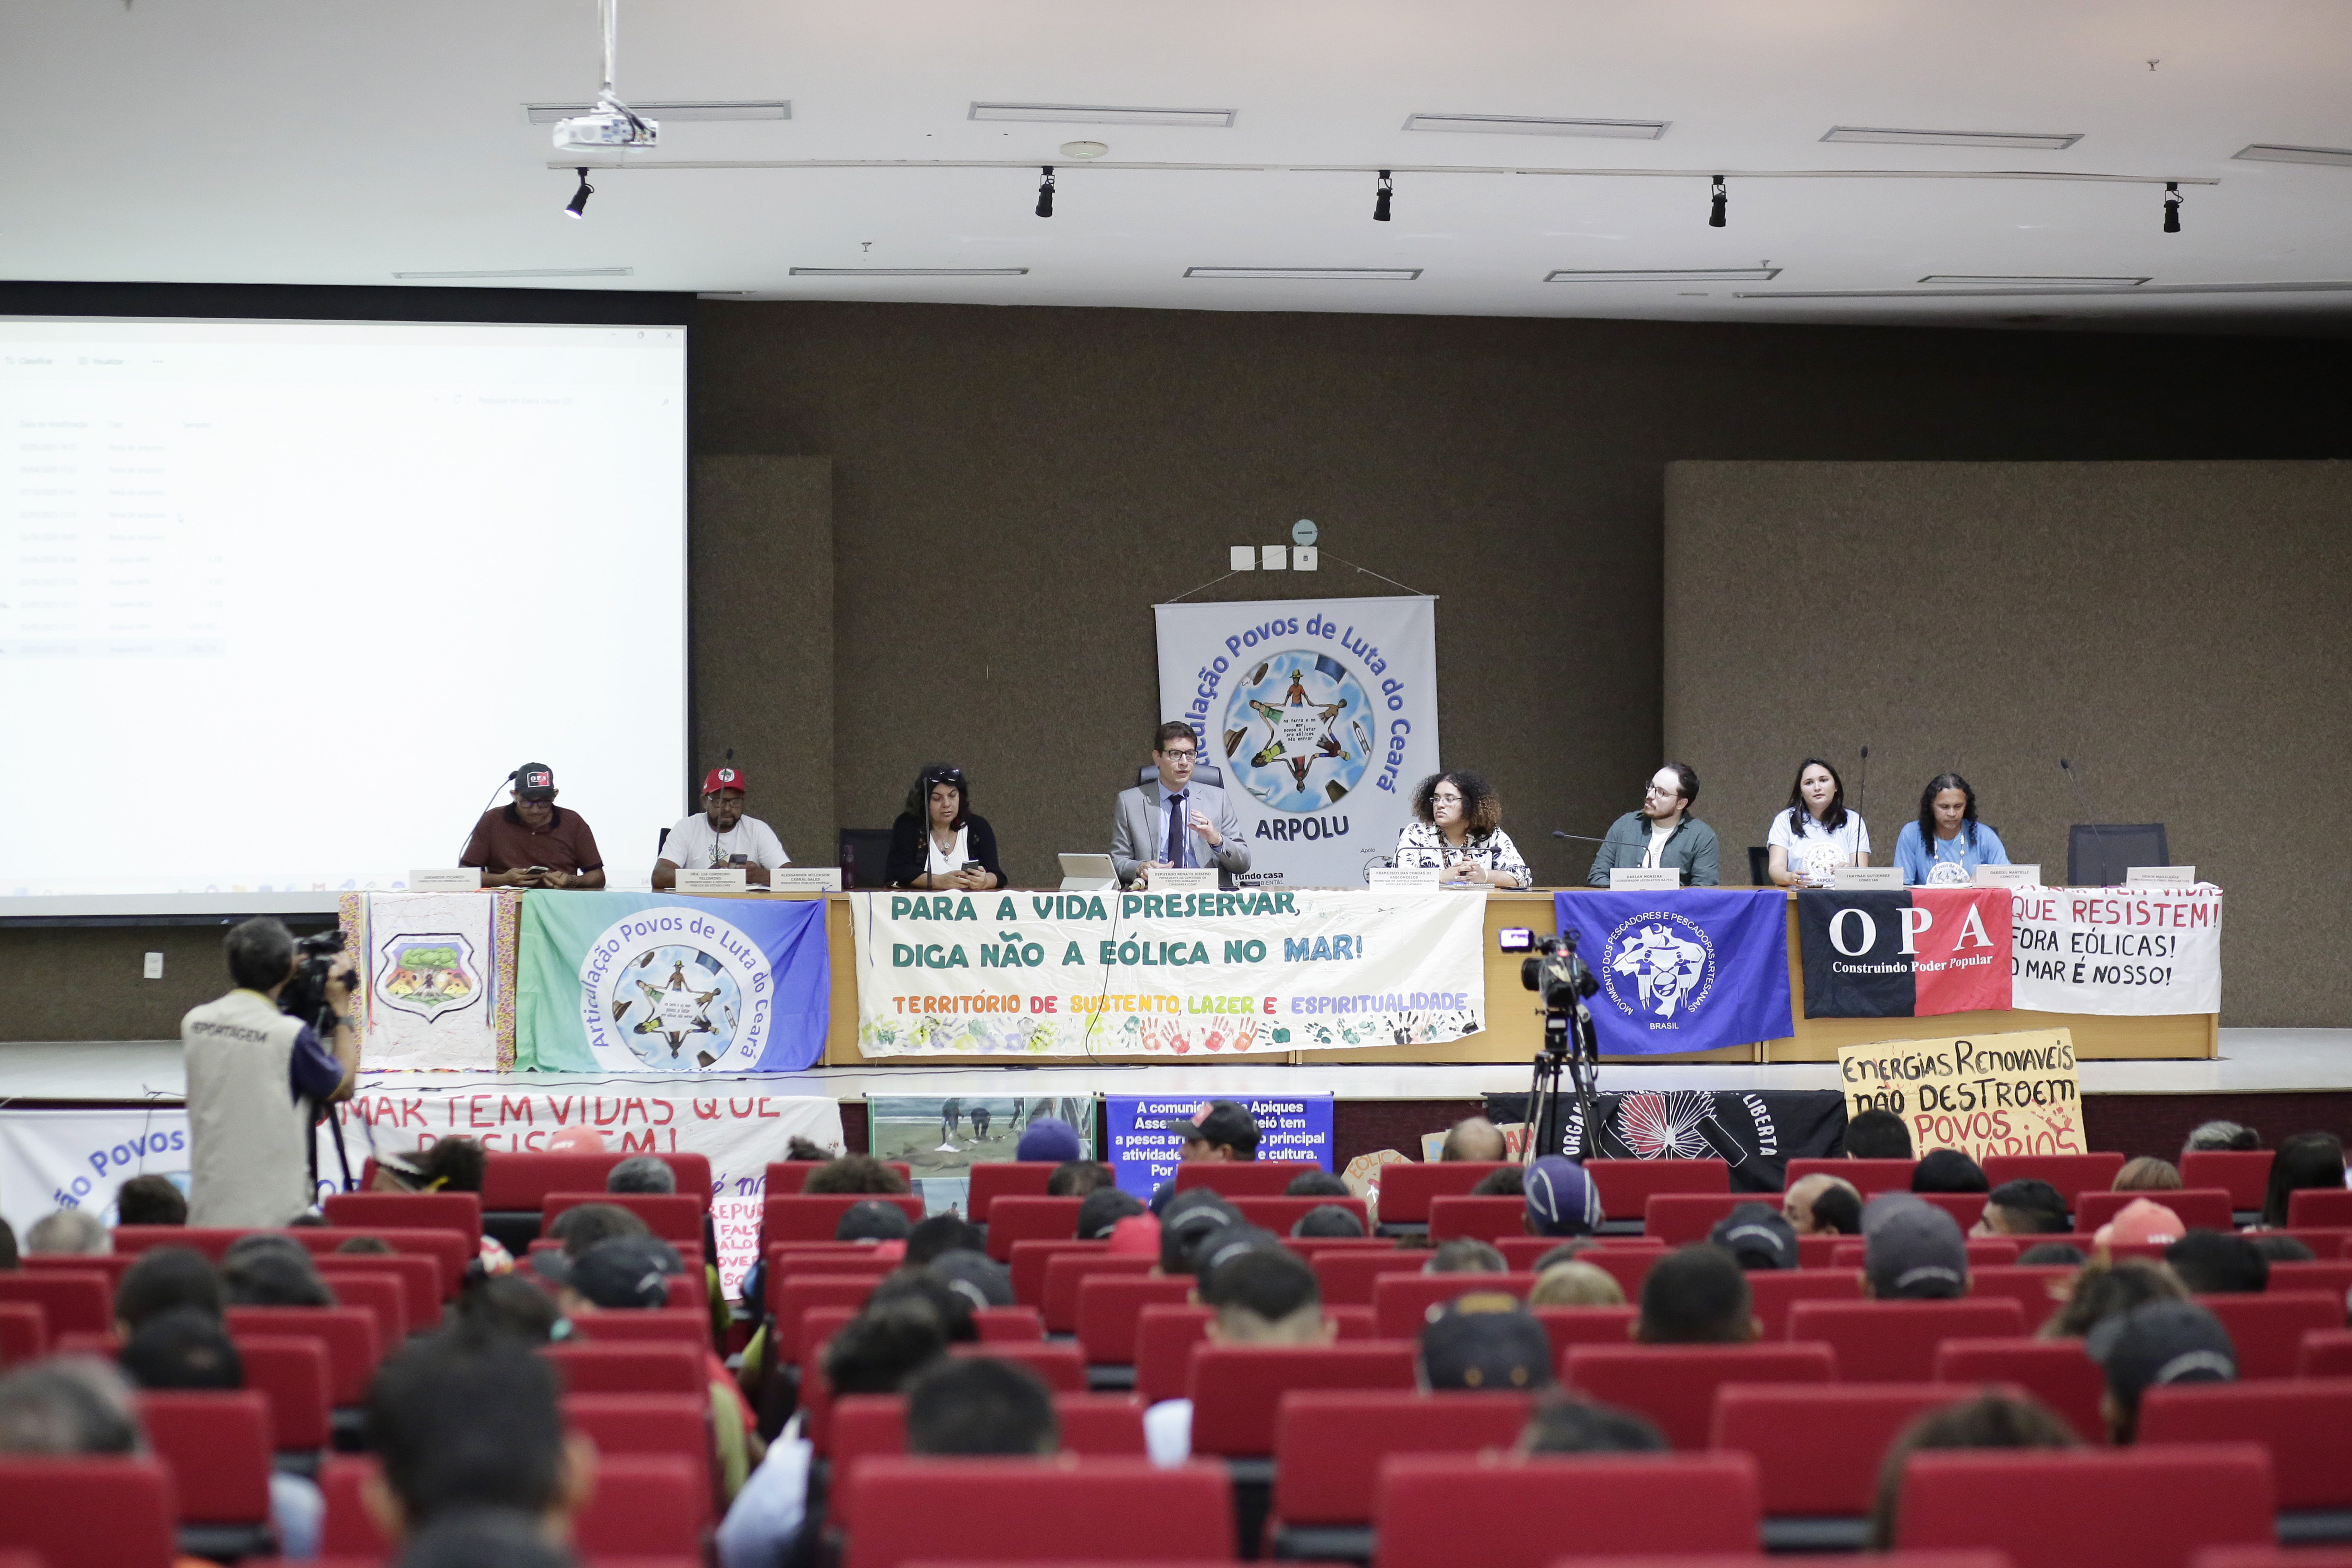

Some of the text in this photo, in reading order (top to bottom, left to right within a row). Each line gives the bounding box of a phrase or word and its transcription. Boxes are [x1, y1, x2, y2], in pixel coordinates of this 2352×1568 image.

[1225, 617, 1298, 658] Povos
[1307, 612, 1336, 639] de
[1341, 626, 1387, 676] Luta
[1381, 678, 1404, 711] do
[1376, 718, 1411, 795] Ceará
[1256, 816, 1350, 842] ARPOLU
[1235, 872, 1261, 880] fundo
[891, 892, 1301, 921] PARA A VIDA PRESERVAR,
[2012, 896, 2219, 928] QUE RESISTEM!
[1607, 911, 1661, 944] PESCADORES
[1671, 913, 1715, 959] PESCADORAS
[2012, 926, 2176, 958] FORA EÓLICAS!
[892, 931, 1362, 968] DIGA NÃO A EÓLICA NO MAR!
[1602, 944, 1613, 964] DOS
[1833, 954, 1993, 973] Construindo Poder Popular
[2026, 959, 2065, 982] MAR
[2073, 956, 2086, 983] É
[2093, 965, 2172, 985] NOSSO!
[581, 917, 768, 1060] Articulação Povos de Luta do Ceará
[893, 990, 1468, 1016] TERRITÓRIO DE SUSTENTO, LAZER E ESPIRITUALIDADE
[1602, 967, 1634, 1015] MOVIMENTO
[1688, 961, 1715, 1013] ARTESANAIS
[440, 1095, 533, 1127] TEM
[547, 1096, 674, 1126] VIDAS
[694, 1097, 781, 1120] QUE
[1137, 1102, 1147, 1114] A
[1251, 1101, 1304, 1118] Apiques
[1280, 1118, 1305, 1128] tem
[1742, 1094, 1777, 1156] LIBERTA
[1115, 1136, 1123, 1145] a
[1126, 1134, 1166, 1147] pesca
[1269, 1132, 1325, 1147] principal
[1914, 1110, 2011, 1144] POVOS
[88, 1130, 185, 1178] Povos
[1122, 1149, 1318, 1161] atividade e cultura.
[1151, 1164, 1173, 1176] Por
